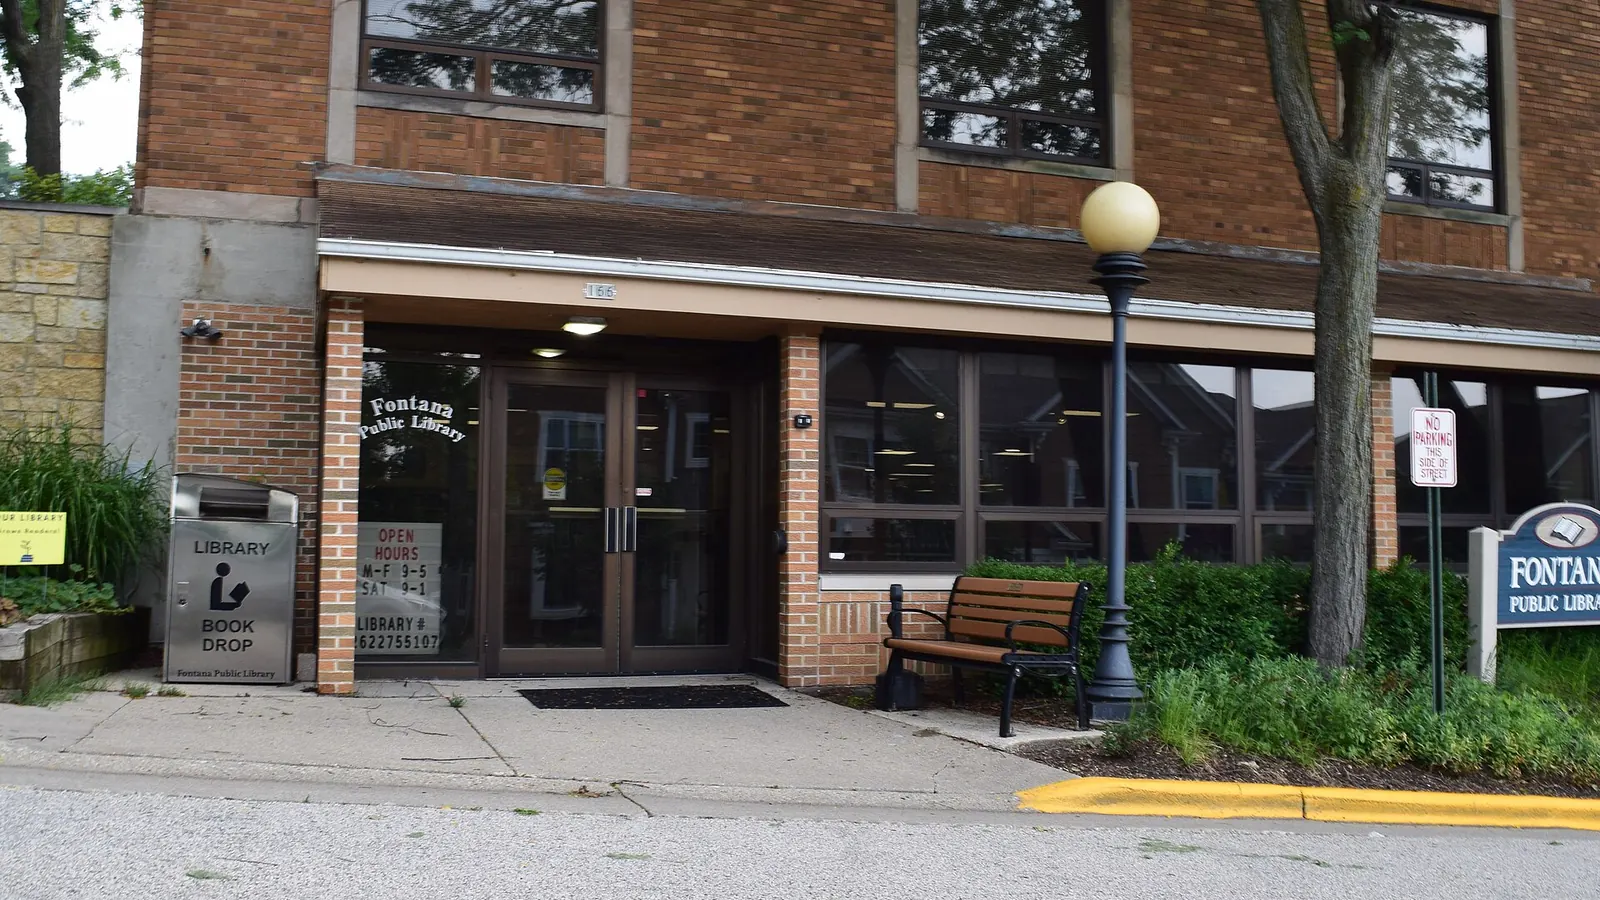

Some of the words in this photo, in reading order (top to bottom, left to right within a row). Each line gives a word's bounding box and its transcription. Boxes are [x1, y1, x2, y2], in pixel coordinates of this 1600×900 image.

[369, 395, 454, 419] Fontana
[359, 417, 406, 440] Public
[411, 415, 466, 443] Library
[1425, 416, 1441, 431] NO
[1413, 431, 1453, 447] PARKING
[1426, 447, 1442, 457] THIS
[1419, 458, 1436, 468] SIDE
[1439, 458, 1448, 468] OF
[1420, 469, 1447, 479] STREET
[379, 528, 414, 543] OPEN
[194, 540, 270, 556] LIBRARY
[375, 546, 418, 561] HOURS
[362, 564, 391, 578] M-F
[402, 564, 426, 578] 9-5
[362, 581, 387, 596] SAT
[402, 582, 425, 596] 9-1
[1509, 595, 1559, 613] PUBLIC
[202, 619, 255, 633] BOOK
[202, 638, 253, 652] DROP
[177, 669, 213, 678] Fontana
[214, 669, 241, 678] Public
[243, 669, 276, 679] Library
